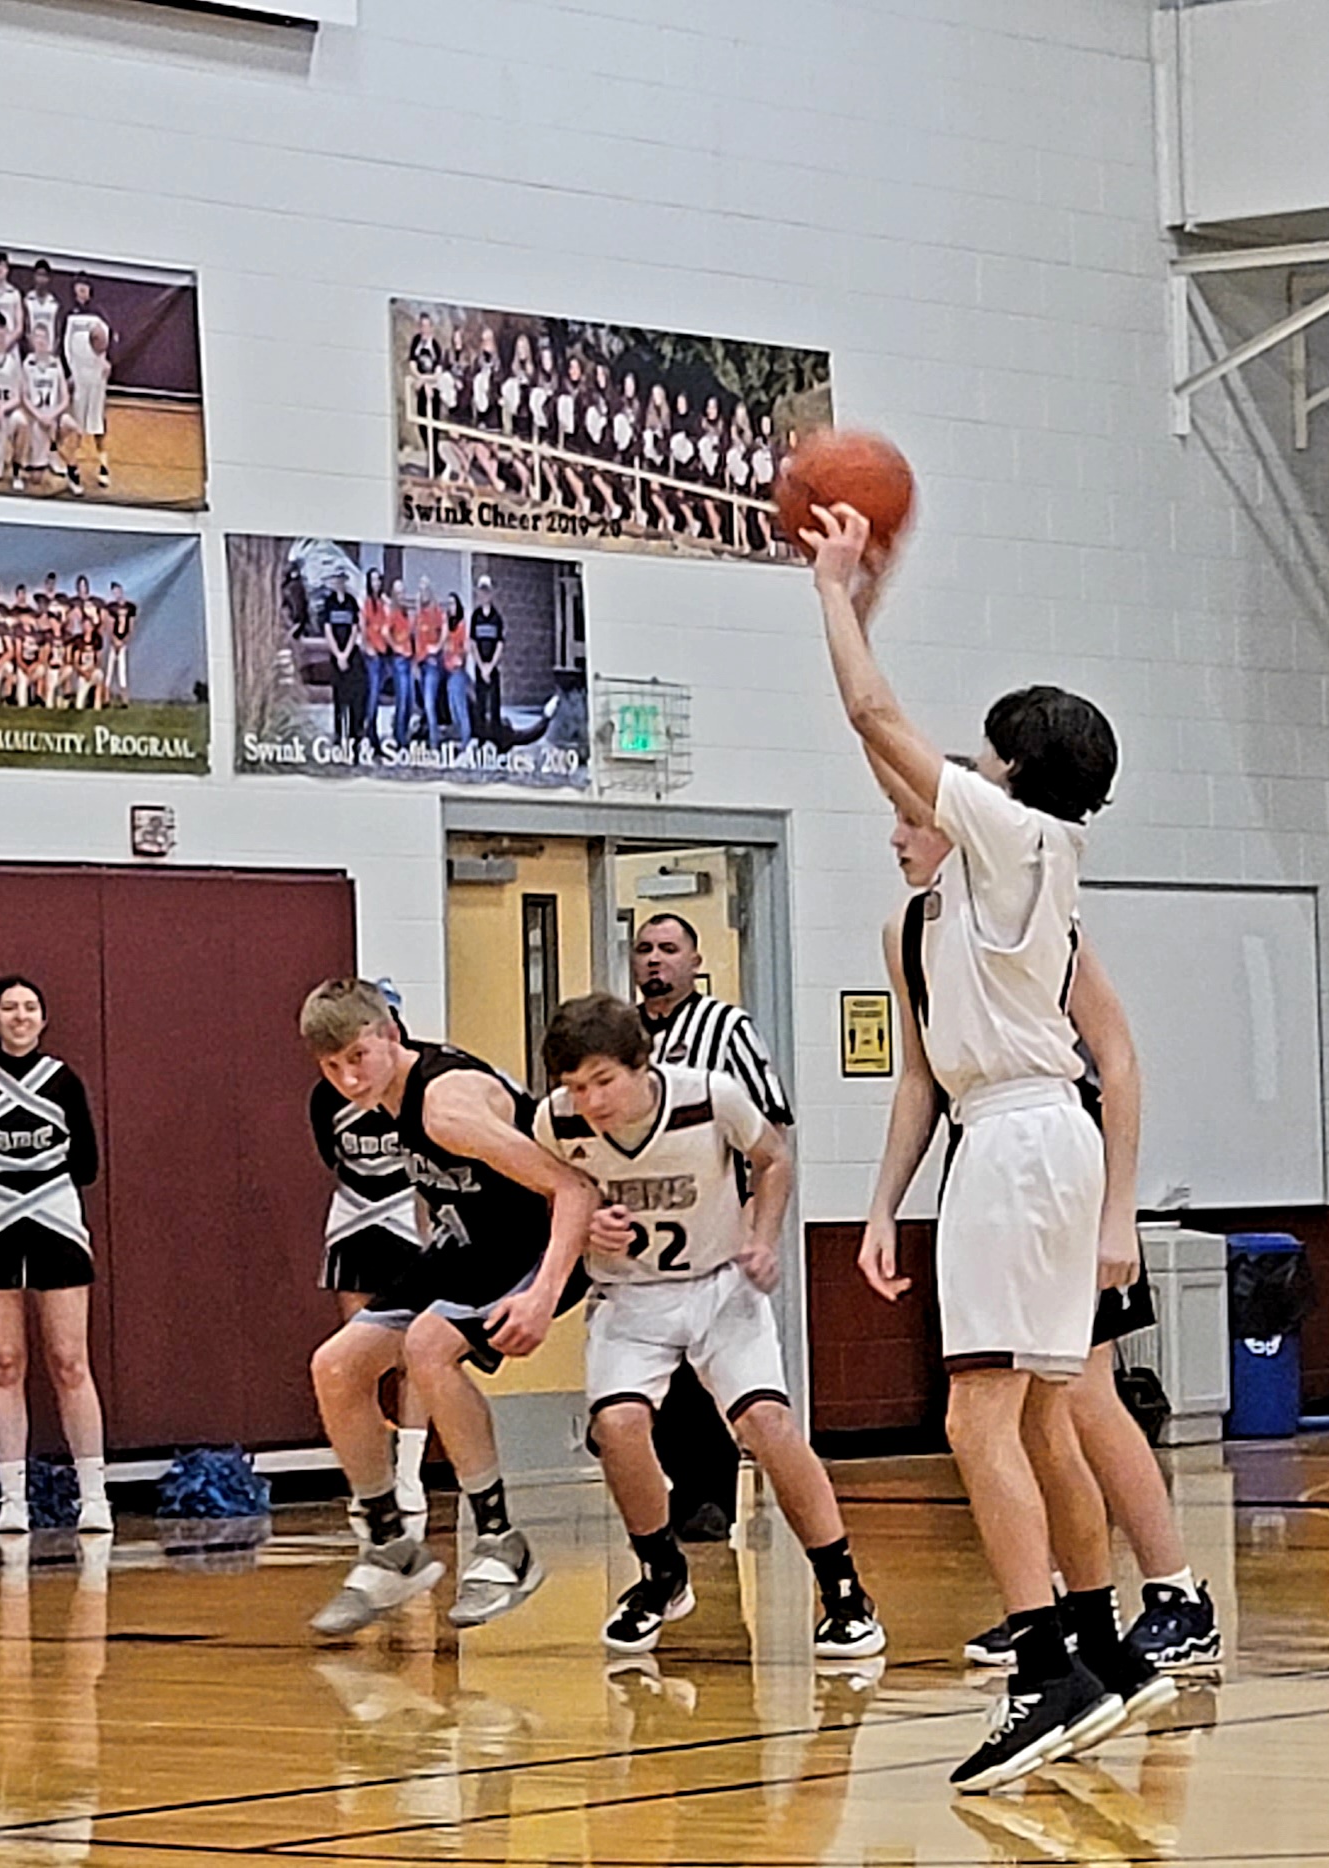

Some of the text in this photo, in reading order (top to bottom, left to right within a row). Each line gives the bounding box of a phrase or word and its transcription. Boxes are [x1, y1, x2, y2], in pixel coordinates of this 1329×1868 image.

[403, 495, 473, 526] Swink
[478, 502, 541, 532] Cheer
[244, 733, 307, 763] Swink
[312, 736, 355, 766] Golf
[358, 736, 374, 766] &
[607, 1173, 698, 1212] IONS
